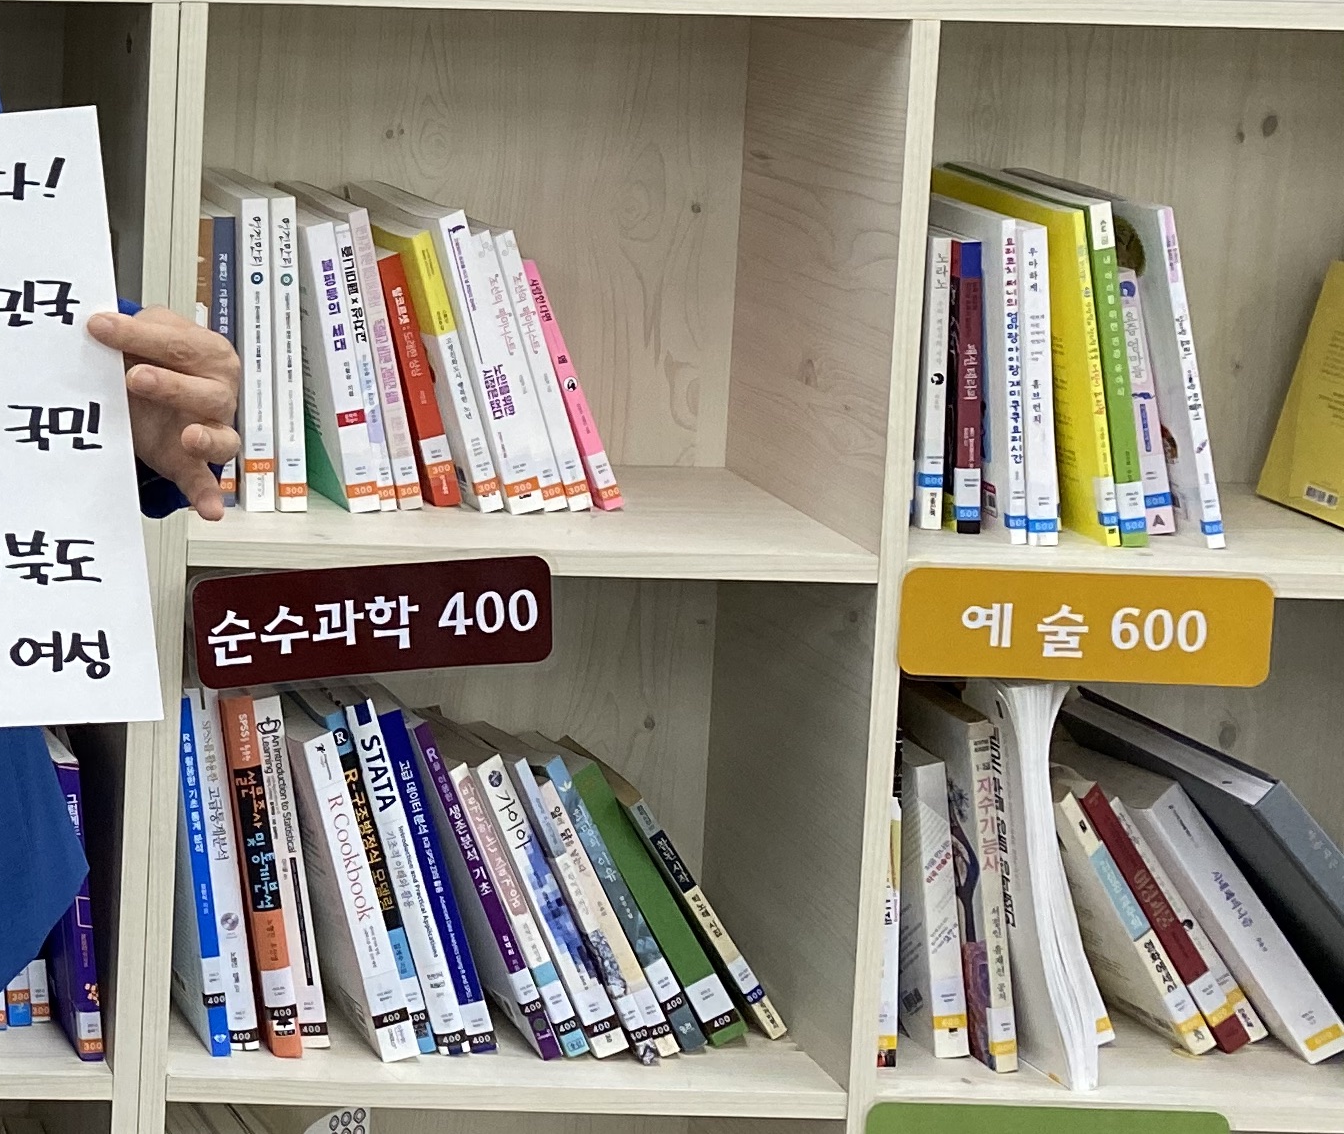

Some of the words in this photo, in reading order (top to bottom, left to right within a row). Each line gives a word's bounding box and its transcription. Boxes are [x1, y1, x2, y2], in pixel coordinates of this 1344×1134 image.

[5, 402, 102, 450] 국민
[207, 595, 419, 668] 순수과학
[437, 588, 539, 637] 400
[1111, 607, 1207, 653] 600
[10, 630, 110, 679] 여성
[361, 734, 397, 813] STATA
[273, 747, 287, 801] Introduction
[282, 812, 296, 853] Statistical
[327, 794, 343, 810] R
[333, 814, 371, 922] Cookbook
[449, 804, 480, 861] 생존분석
[472, 866, 493, 896] 기초
[251, 852, 279, 909] 통계분석
[273, 1008, 292, 1018] 400
[382, 1013, 401, 1023] 400
[523, 1001, 542, 1014] 400
[593, 1020, 611, 1033] 400
[713, 1014, 731, 1028] 400
[442, 1033, 461, 1043] 400
[472, 1034, 491, 1044] 400
